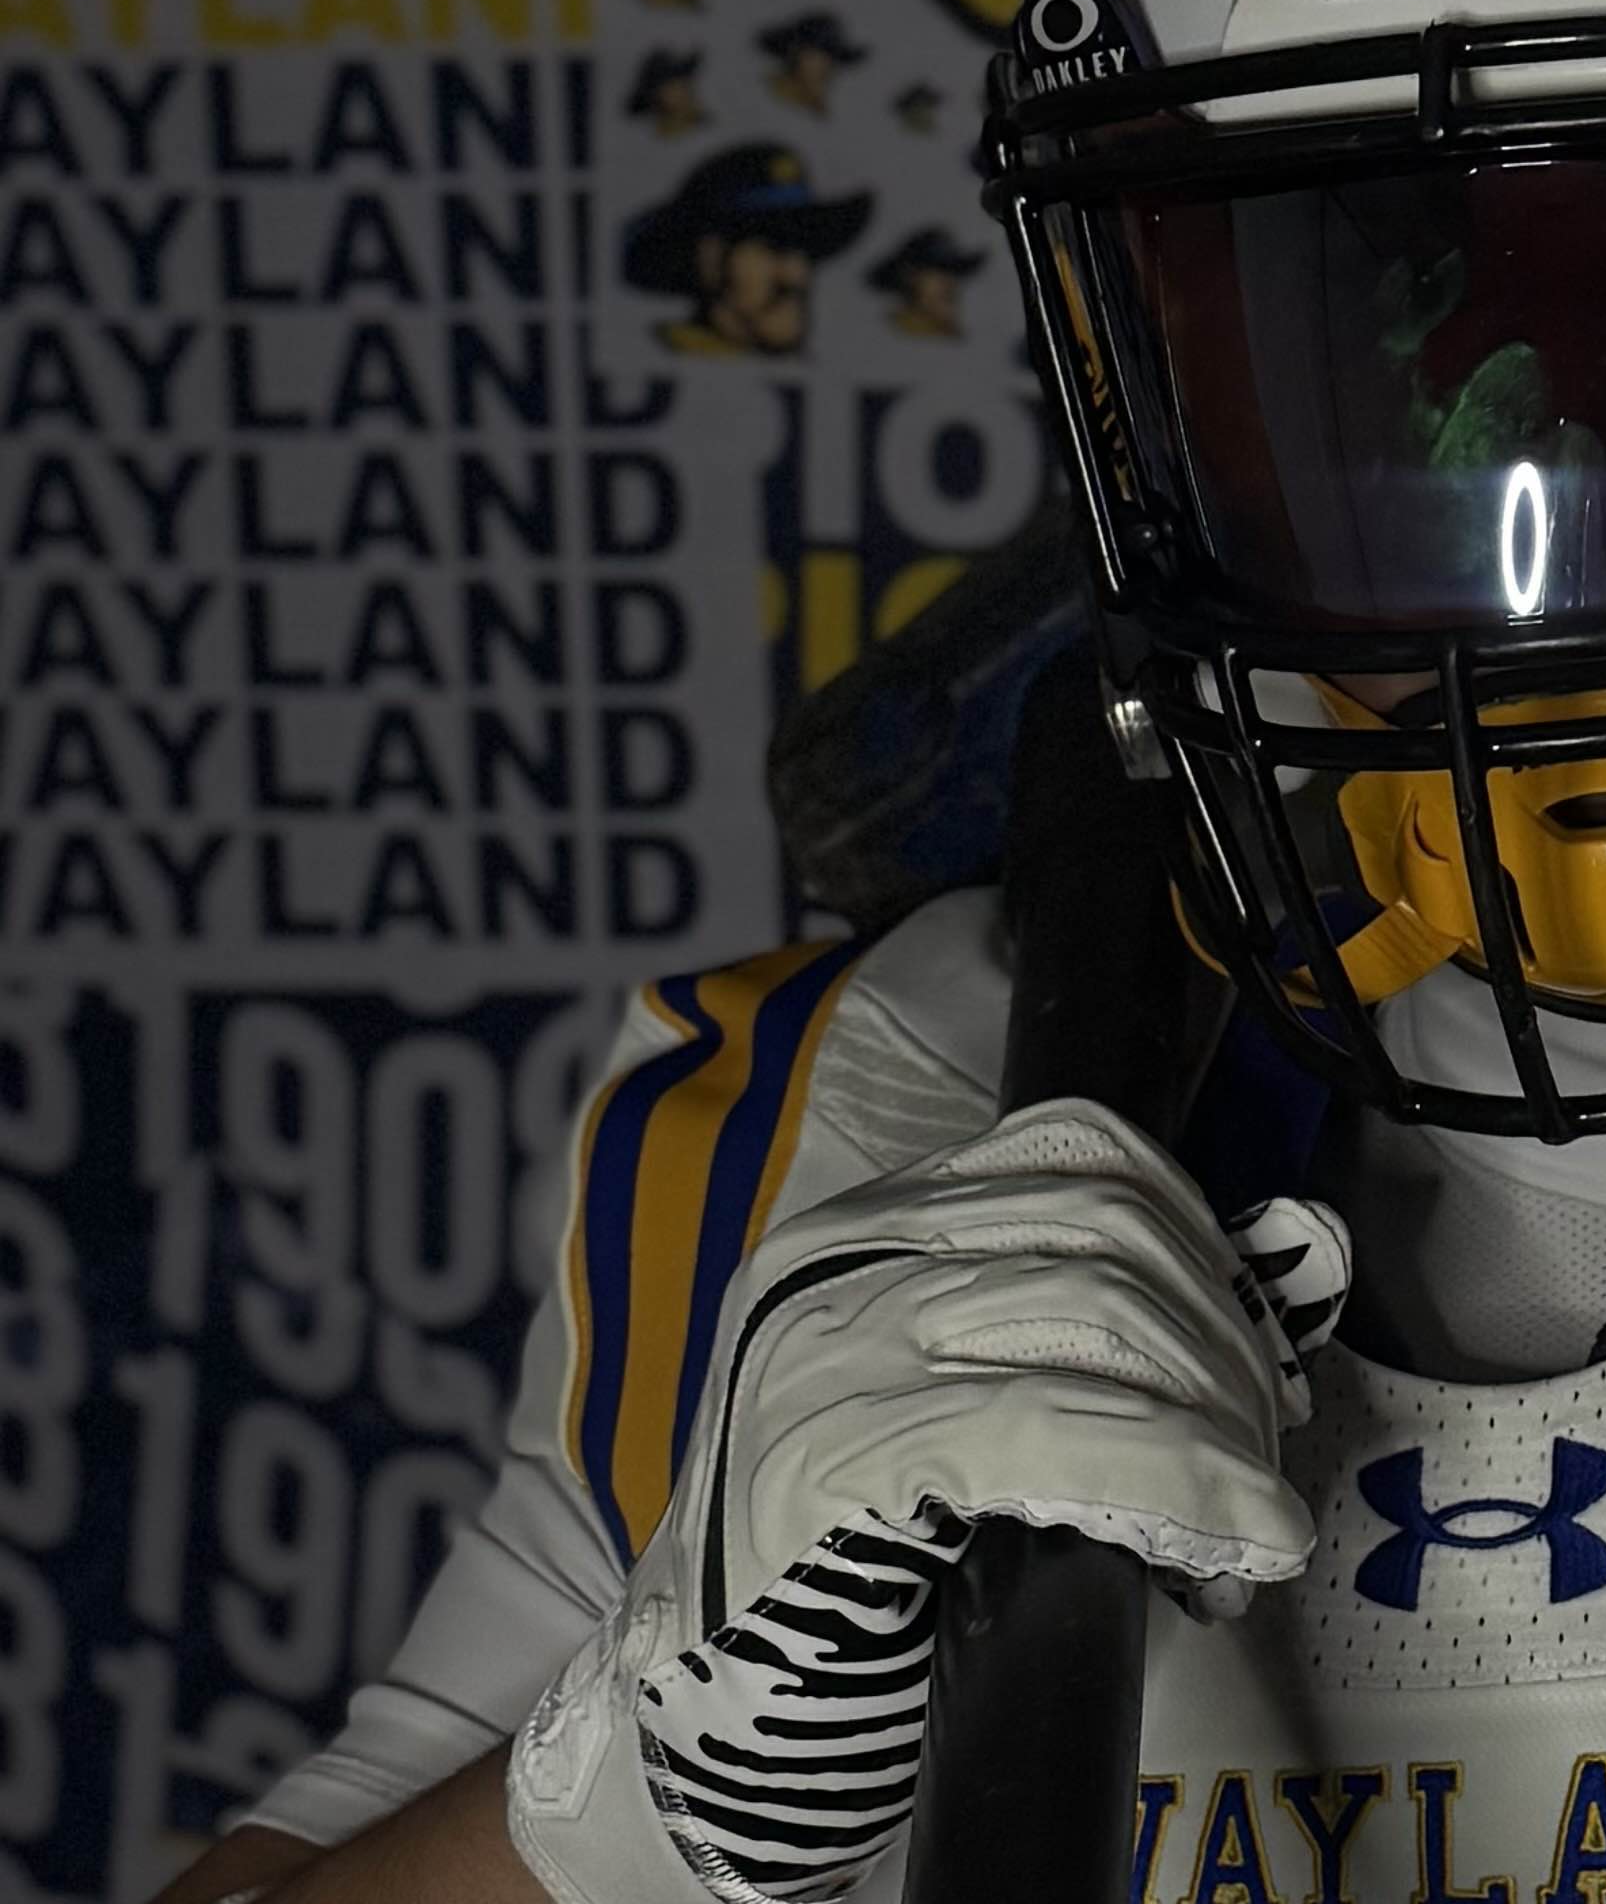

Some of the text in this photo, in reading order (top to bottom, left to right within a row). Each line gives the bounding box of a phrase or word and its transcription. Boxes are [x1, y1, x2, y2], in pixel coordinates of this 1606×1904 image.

[1031, 45, 1127, 96] OAKLEY
[0, 193, 590, 302] AYLAN
[0, 706, 695, 812] AYLAND
[0, 830, 700, 938] AYLAND
